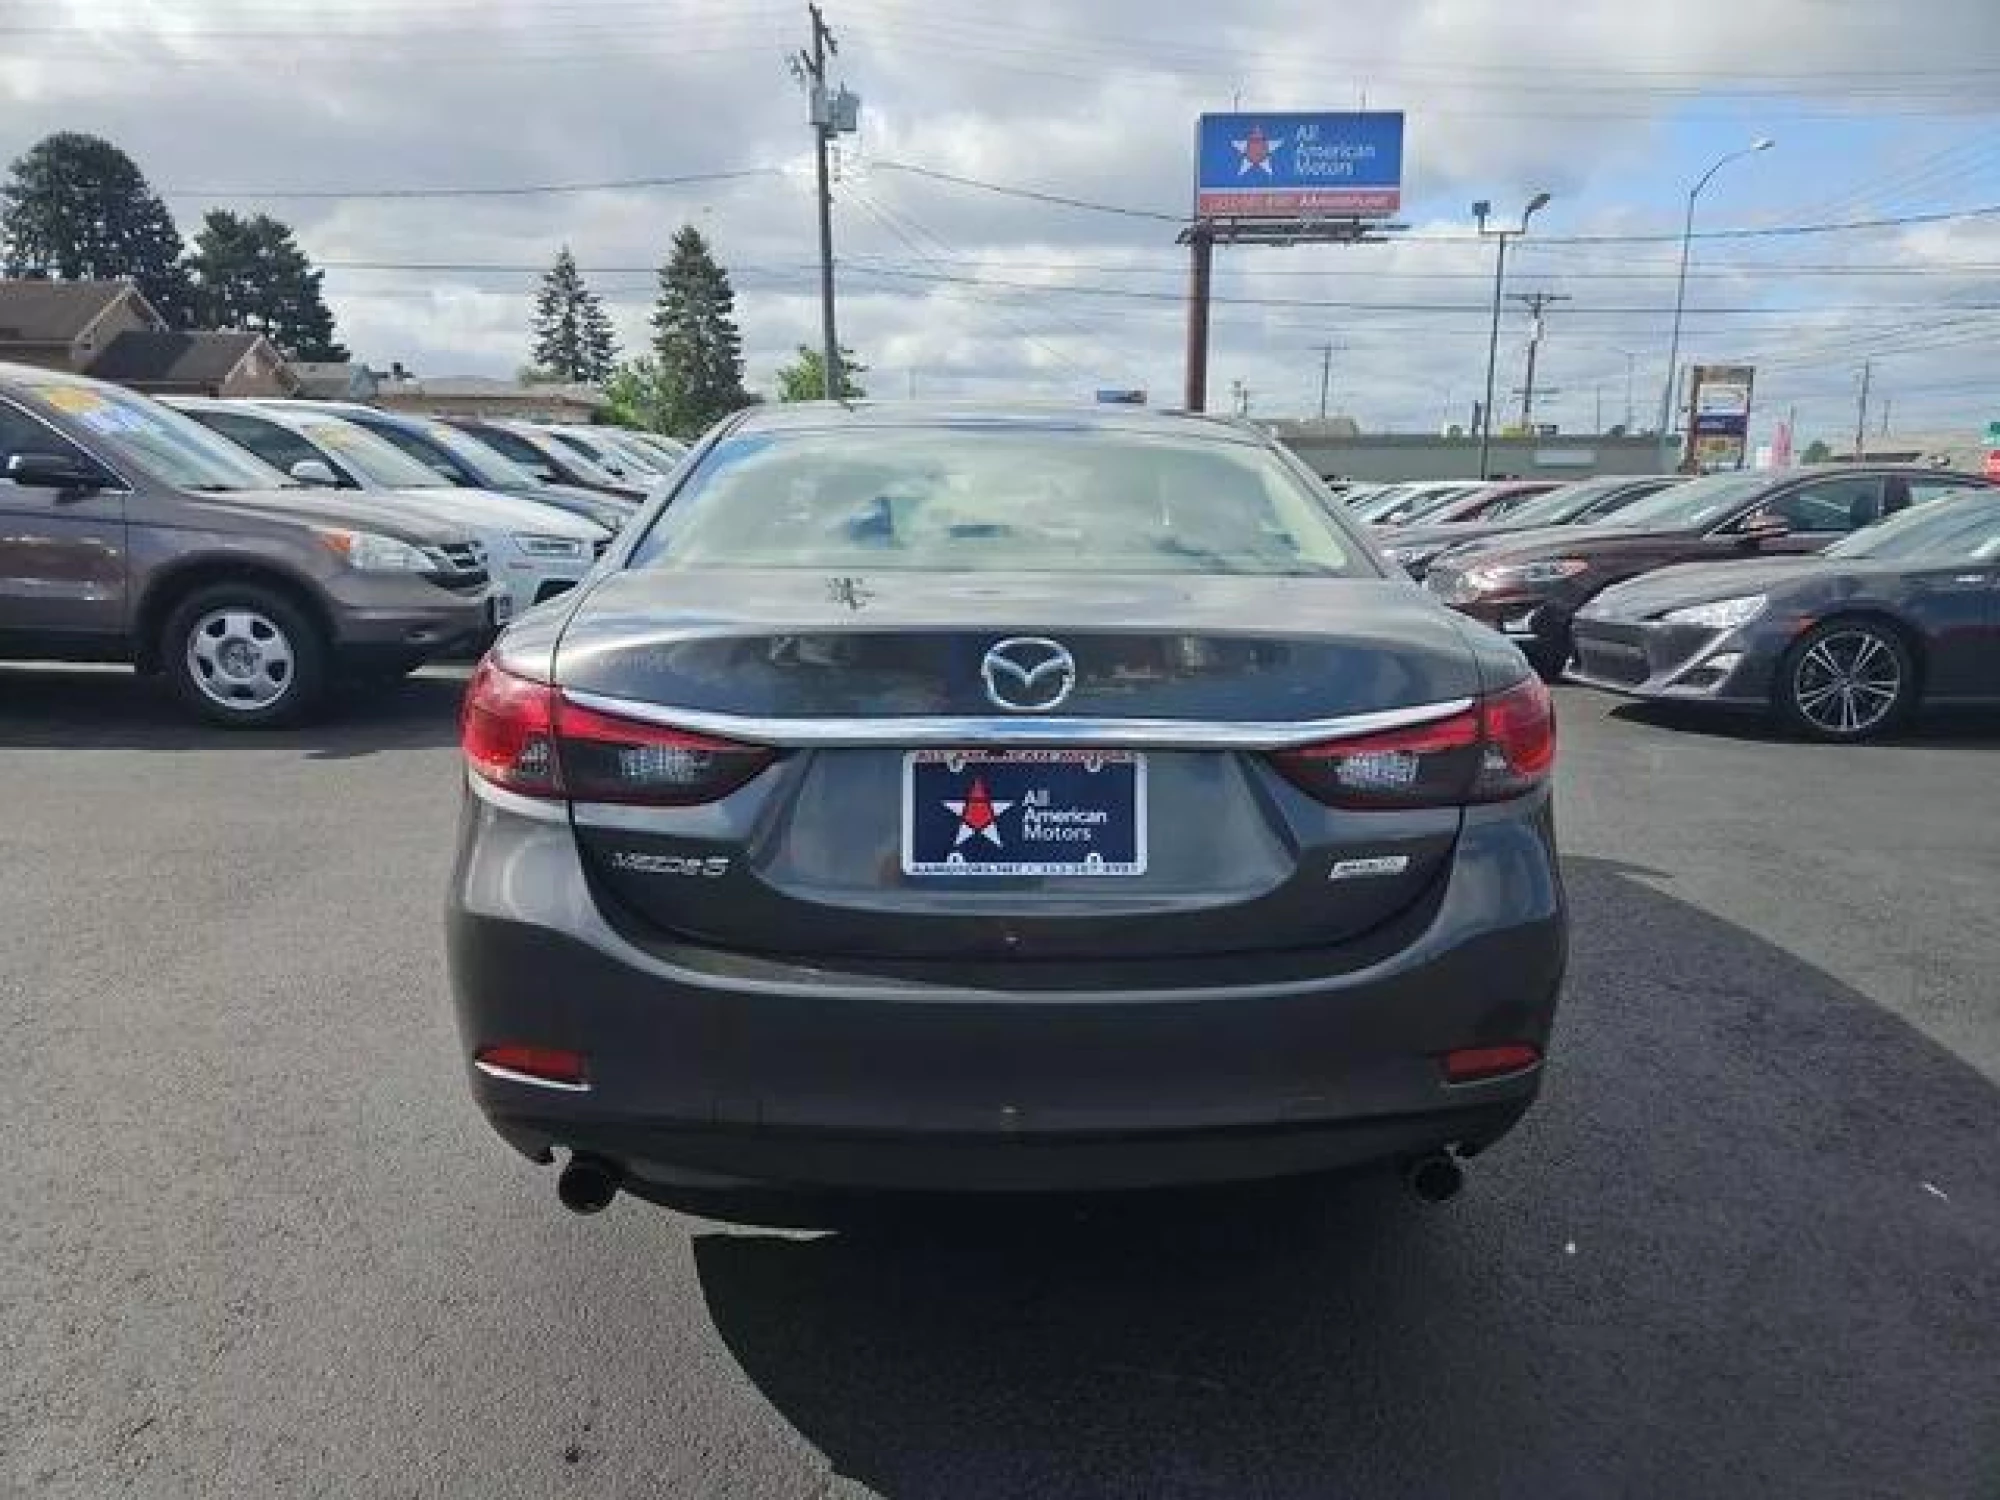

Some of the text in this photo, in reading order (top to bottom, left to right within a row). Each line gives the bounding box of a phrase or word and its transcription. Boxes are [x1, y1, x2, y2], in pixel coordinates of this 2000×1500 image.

[1022, 789, 1050, 806] All
[1023, 806, 1107, 823] American
[1023, 824, 1091, 841] Motors
